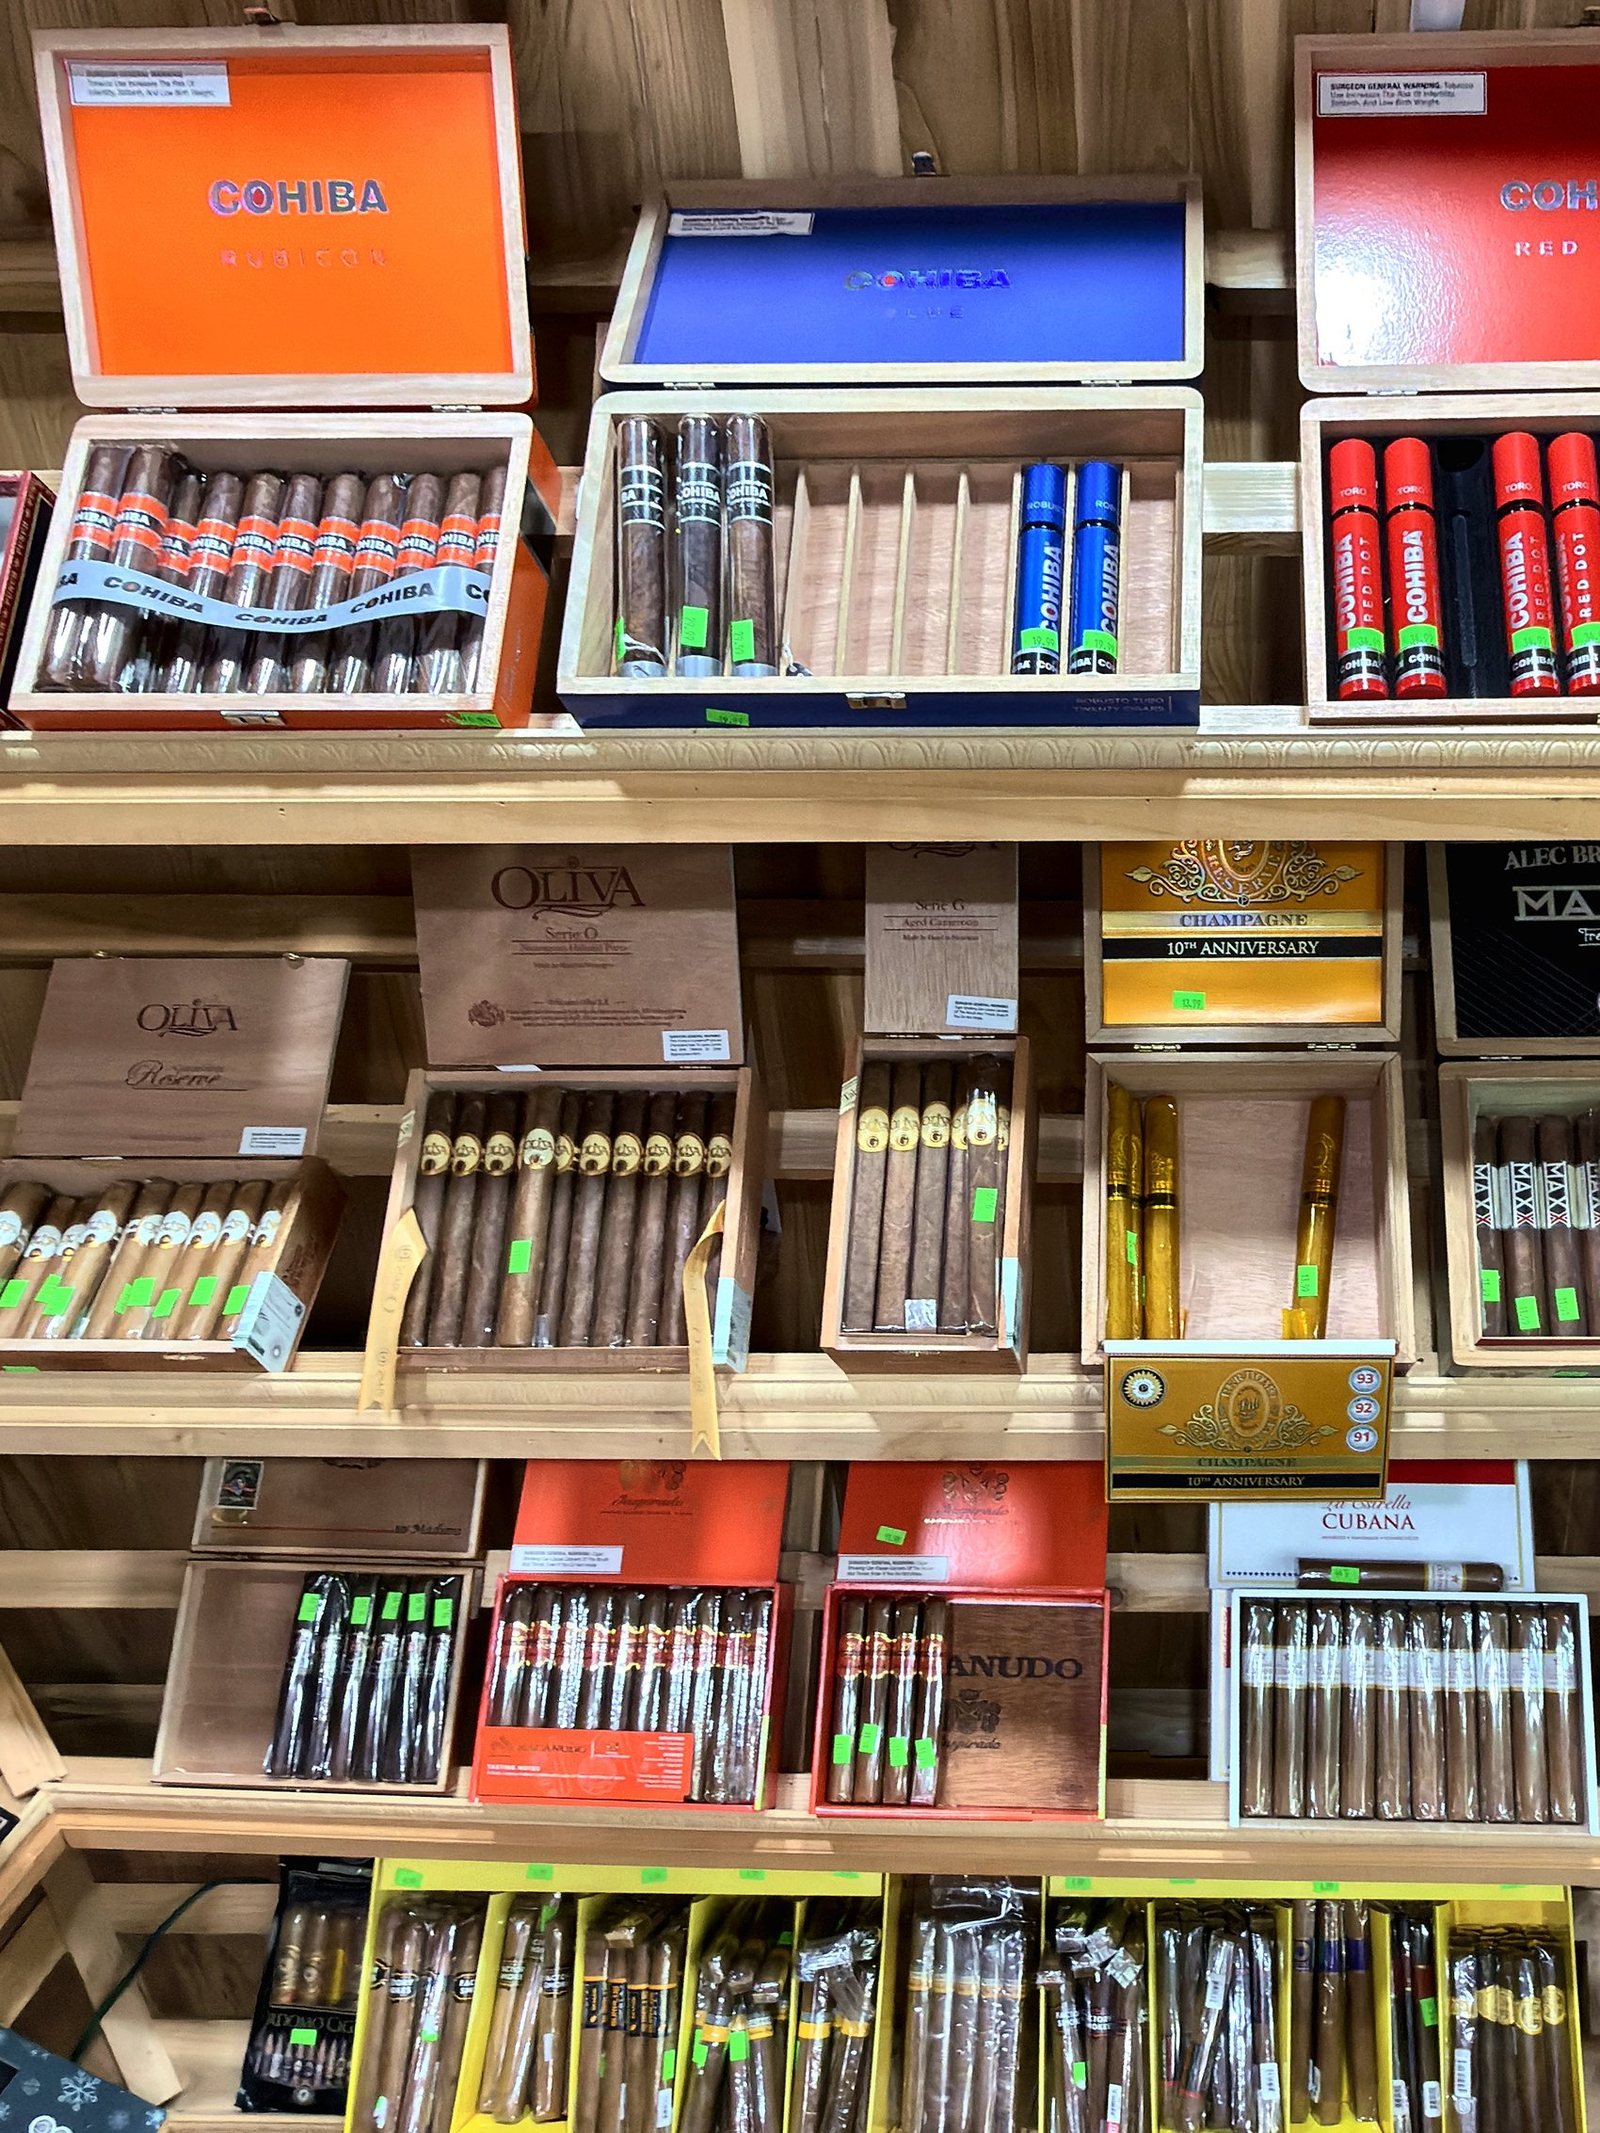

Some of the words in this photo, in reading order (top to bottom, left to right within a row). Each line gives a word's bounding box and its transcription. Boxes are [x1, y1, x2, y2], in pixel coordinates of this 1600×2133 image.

[209, 179, 388, 215] COHIBA
[1501, 180, 1598, 212] COH
[1515, 241, 1578, 256] RED
[845, 269, 1011, 291] COHIBA
[887, 307, 964, 319] LUE
[1340, 487, 1367, 497] TORO
[1397, 485, 1424, 494] TORO
[1505, 482, 1531, 493] TORO
[1562, 481, 1588, 491] TORO
[1360, 537, 1371, 575] DOT
[1572, 532, 1588, 571] DOT
[1336, 533, 1356, 631] COHIBA
[1403, 531, 1428, 623] COHIBA
[1506, 531, 1530, 630] COHIBA
[104, 576, 204, 613] COHIBA
[351, 582, 435, 614] COHIBA
[1101, 545, 1118, 636] COHIBA
[1535, 582, 1545, 622] RED
[1577, 579, 1592, 618] RED
[1363, 586, 1373, 623] RED
[235, 612, 327, 626] COHIBA
[1504, 847, 1567, 870] ALEC
[1573, 846, 1600, 864] BR
[491, 864, 646, 910] OLIVA
[915, 900, 948, 911] Serie
[952, 899, 965, 911] G
[1180, 914, 1308, 927] CHAMPAGNE
[584, 926, 599, 940] O
[1167, 941, 1197, 956] 10TH
[1200, 940, 1320, 956] ANNIVERSARY
[137, 1001, 238, 1034] OLIVA
[1511, 1162, 1537, 1228] MAXX
[1543, 1161, 1571, 1228] MAXX
[1357, 1374, 1374, 1384] 93
[1355, 1404, 1372, 1414] 92
[1354, 1433, 1370, 1442] 91
[1198, 1458, 1297, 1467] CHAMPAGNE
[1213, 1477, 1305, 1486] ANNIVERSARY
[1323, 1513, 1415, 1530] CUBANA
[947, 1655, 1083, 1679] ANUDO
